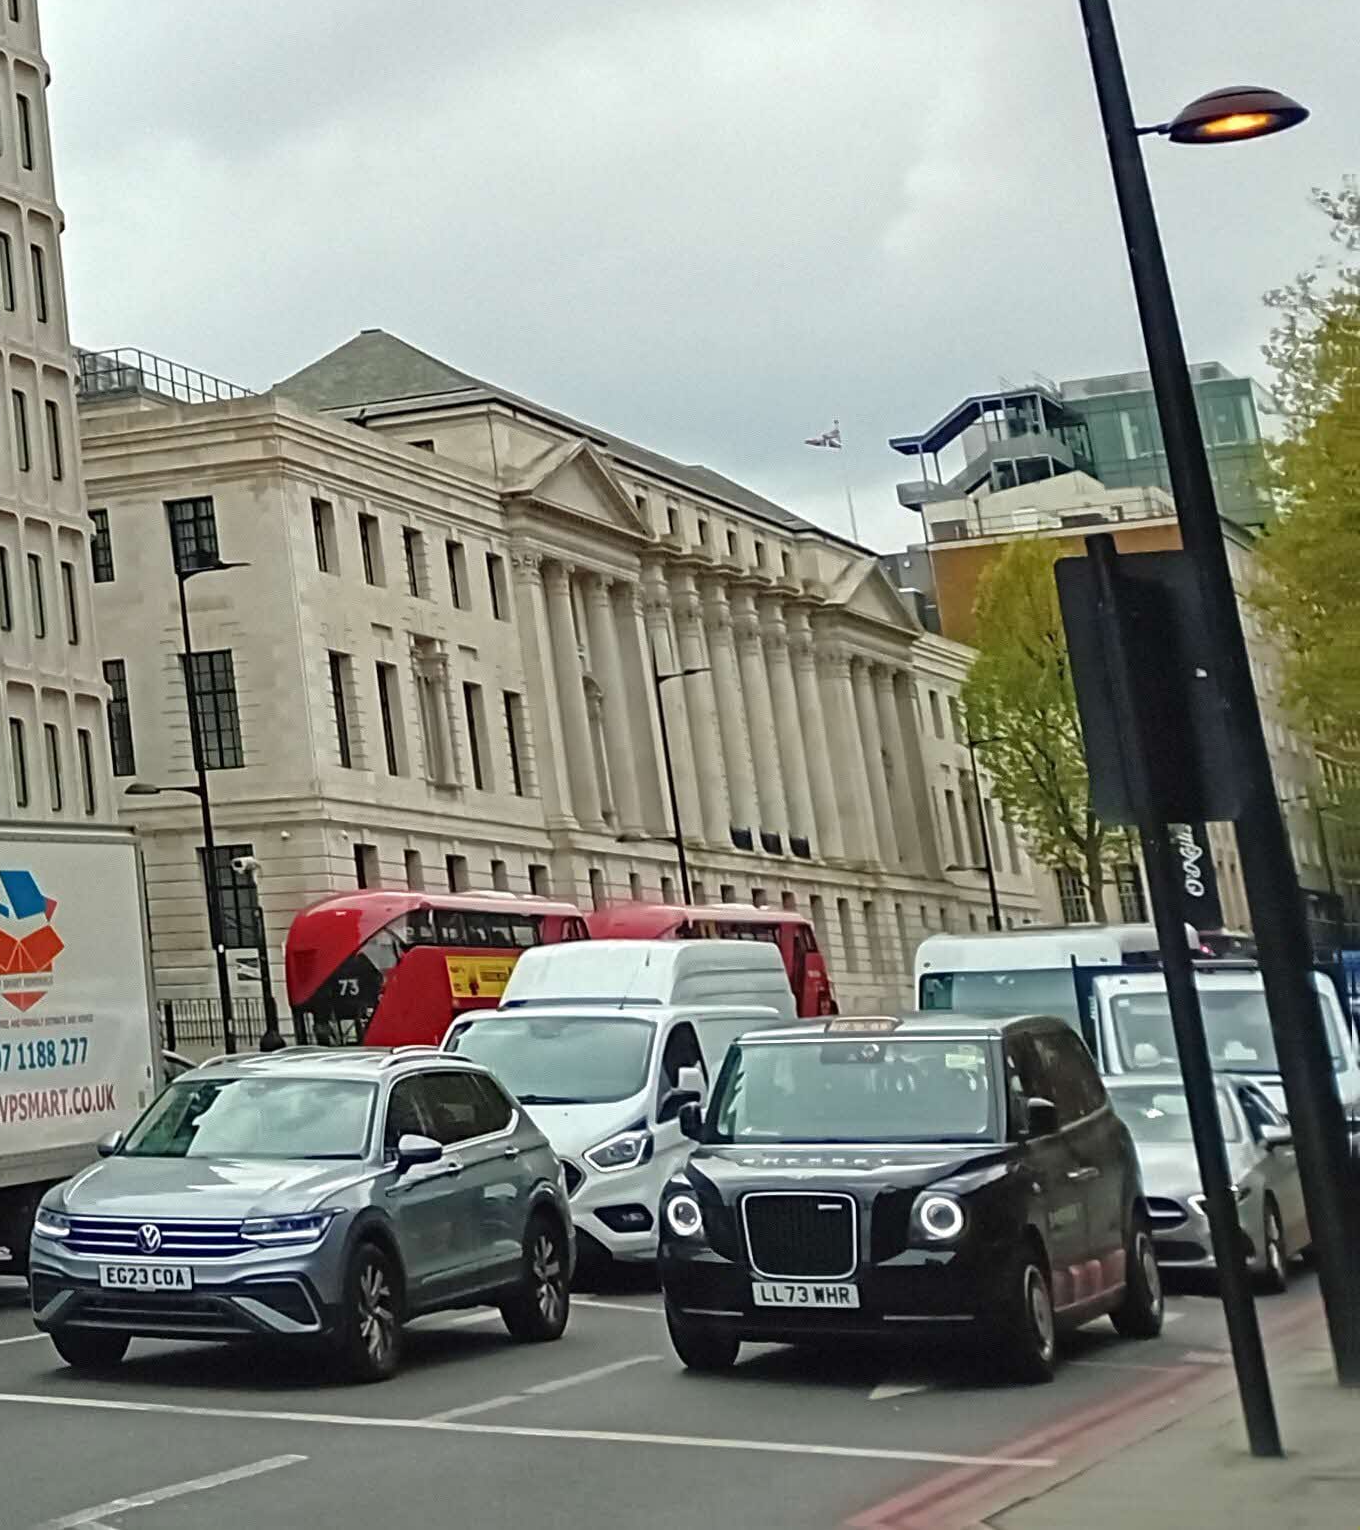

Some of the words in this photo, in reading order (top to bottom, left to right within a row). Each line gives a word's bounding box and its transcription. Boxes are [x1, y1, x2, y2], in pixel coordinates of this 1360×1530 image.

[338, 978, 360, 997] 73
[17, 1039, 57, 1070] 1188
[60, 1036, 88, 1066] 277
[106, 1267, 148, 1285] EG23
[152, 1268, 186, 1287] COA
[760, 1285, 809, 1303] LL73
[812, 1286, 850, 1304] WHR
